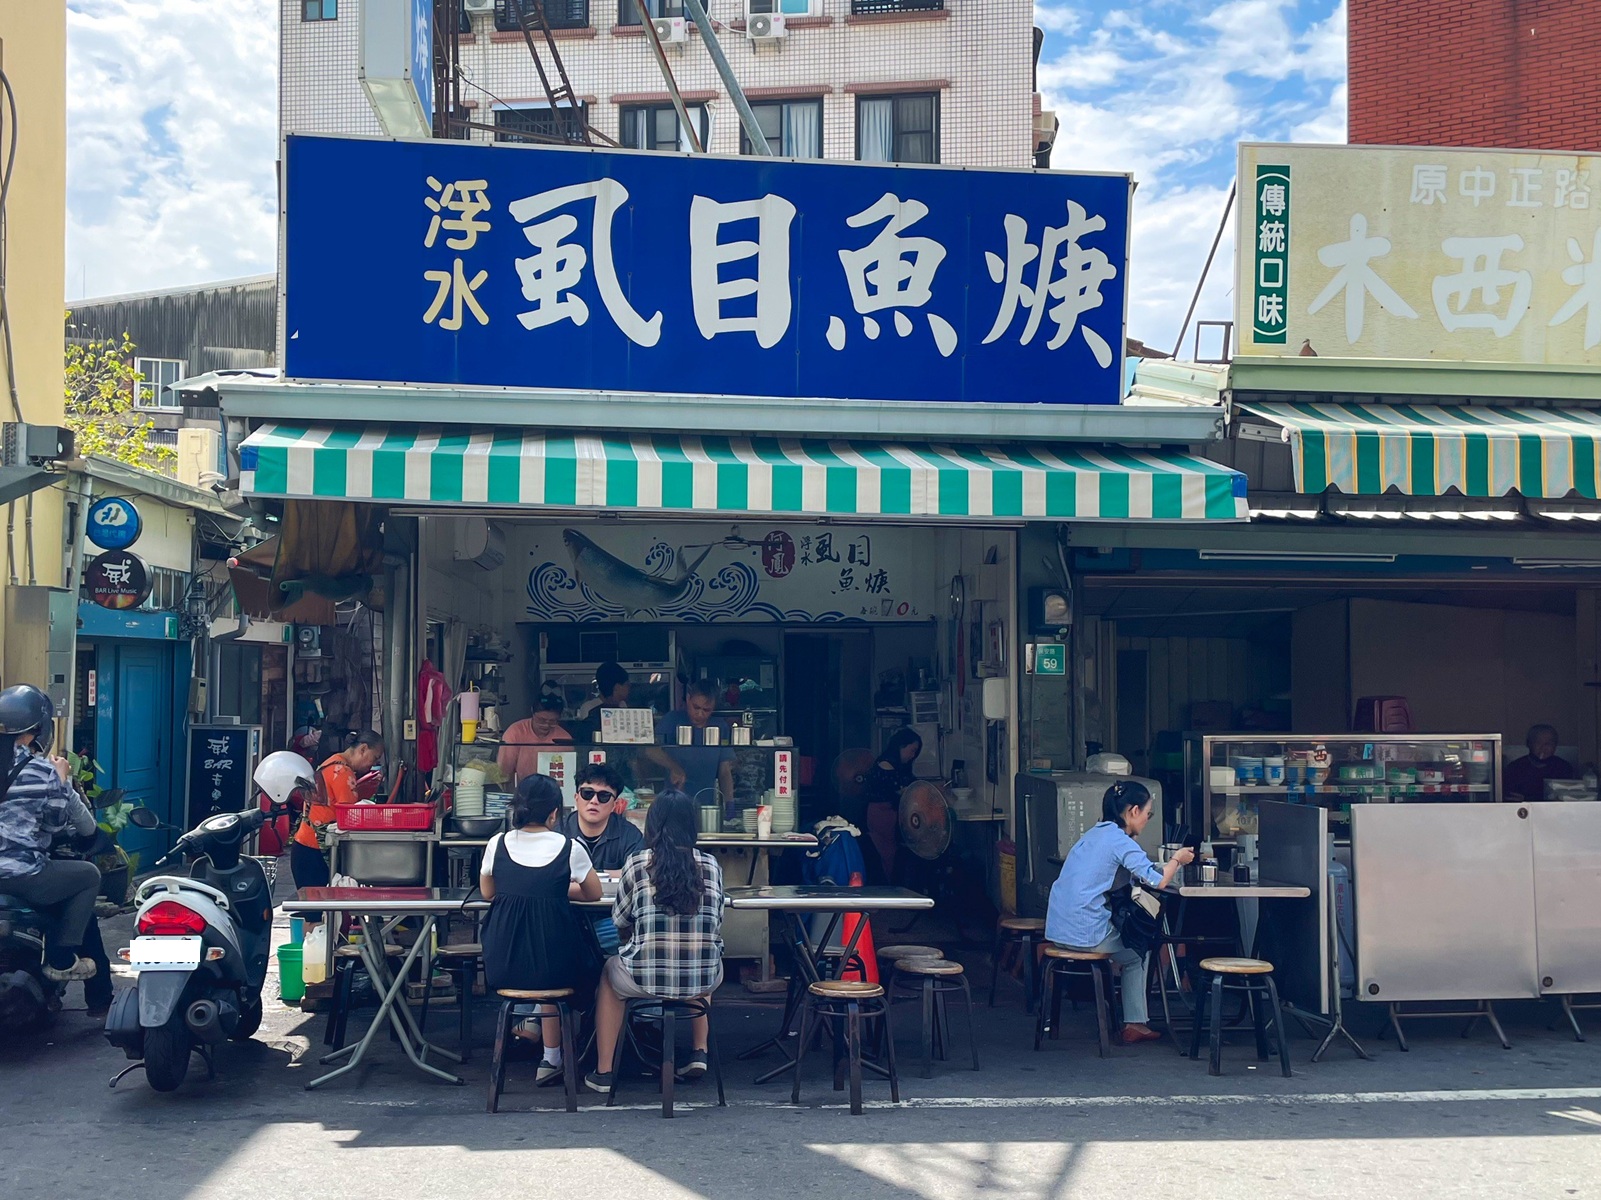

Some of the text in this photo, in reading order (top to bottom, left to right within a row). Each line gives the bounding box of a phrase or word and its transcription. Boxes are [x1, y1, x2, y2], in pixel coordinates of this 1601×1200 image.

[1409, 163, 1592, 210] 原中正路
[422, 175, 492, 331] 浮水
[1258, 183, 1286, 326] 傳統口味
[767, 532, 790, 574] 阿鳳
[801, 535, 813, 566] 浮水
[815, 532, 871, 567] 虱目
[1043, 658, 1058, 669] 59
[204, 759, 233, 770] BAR
[779, 754, 788, 795] 請先付款
